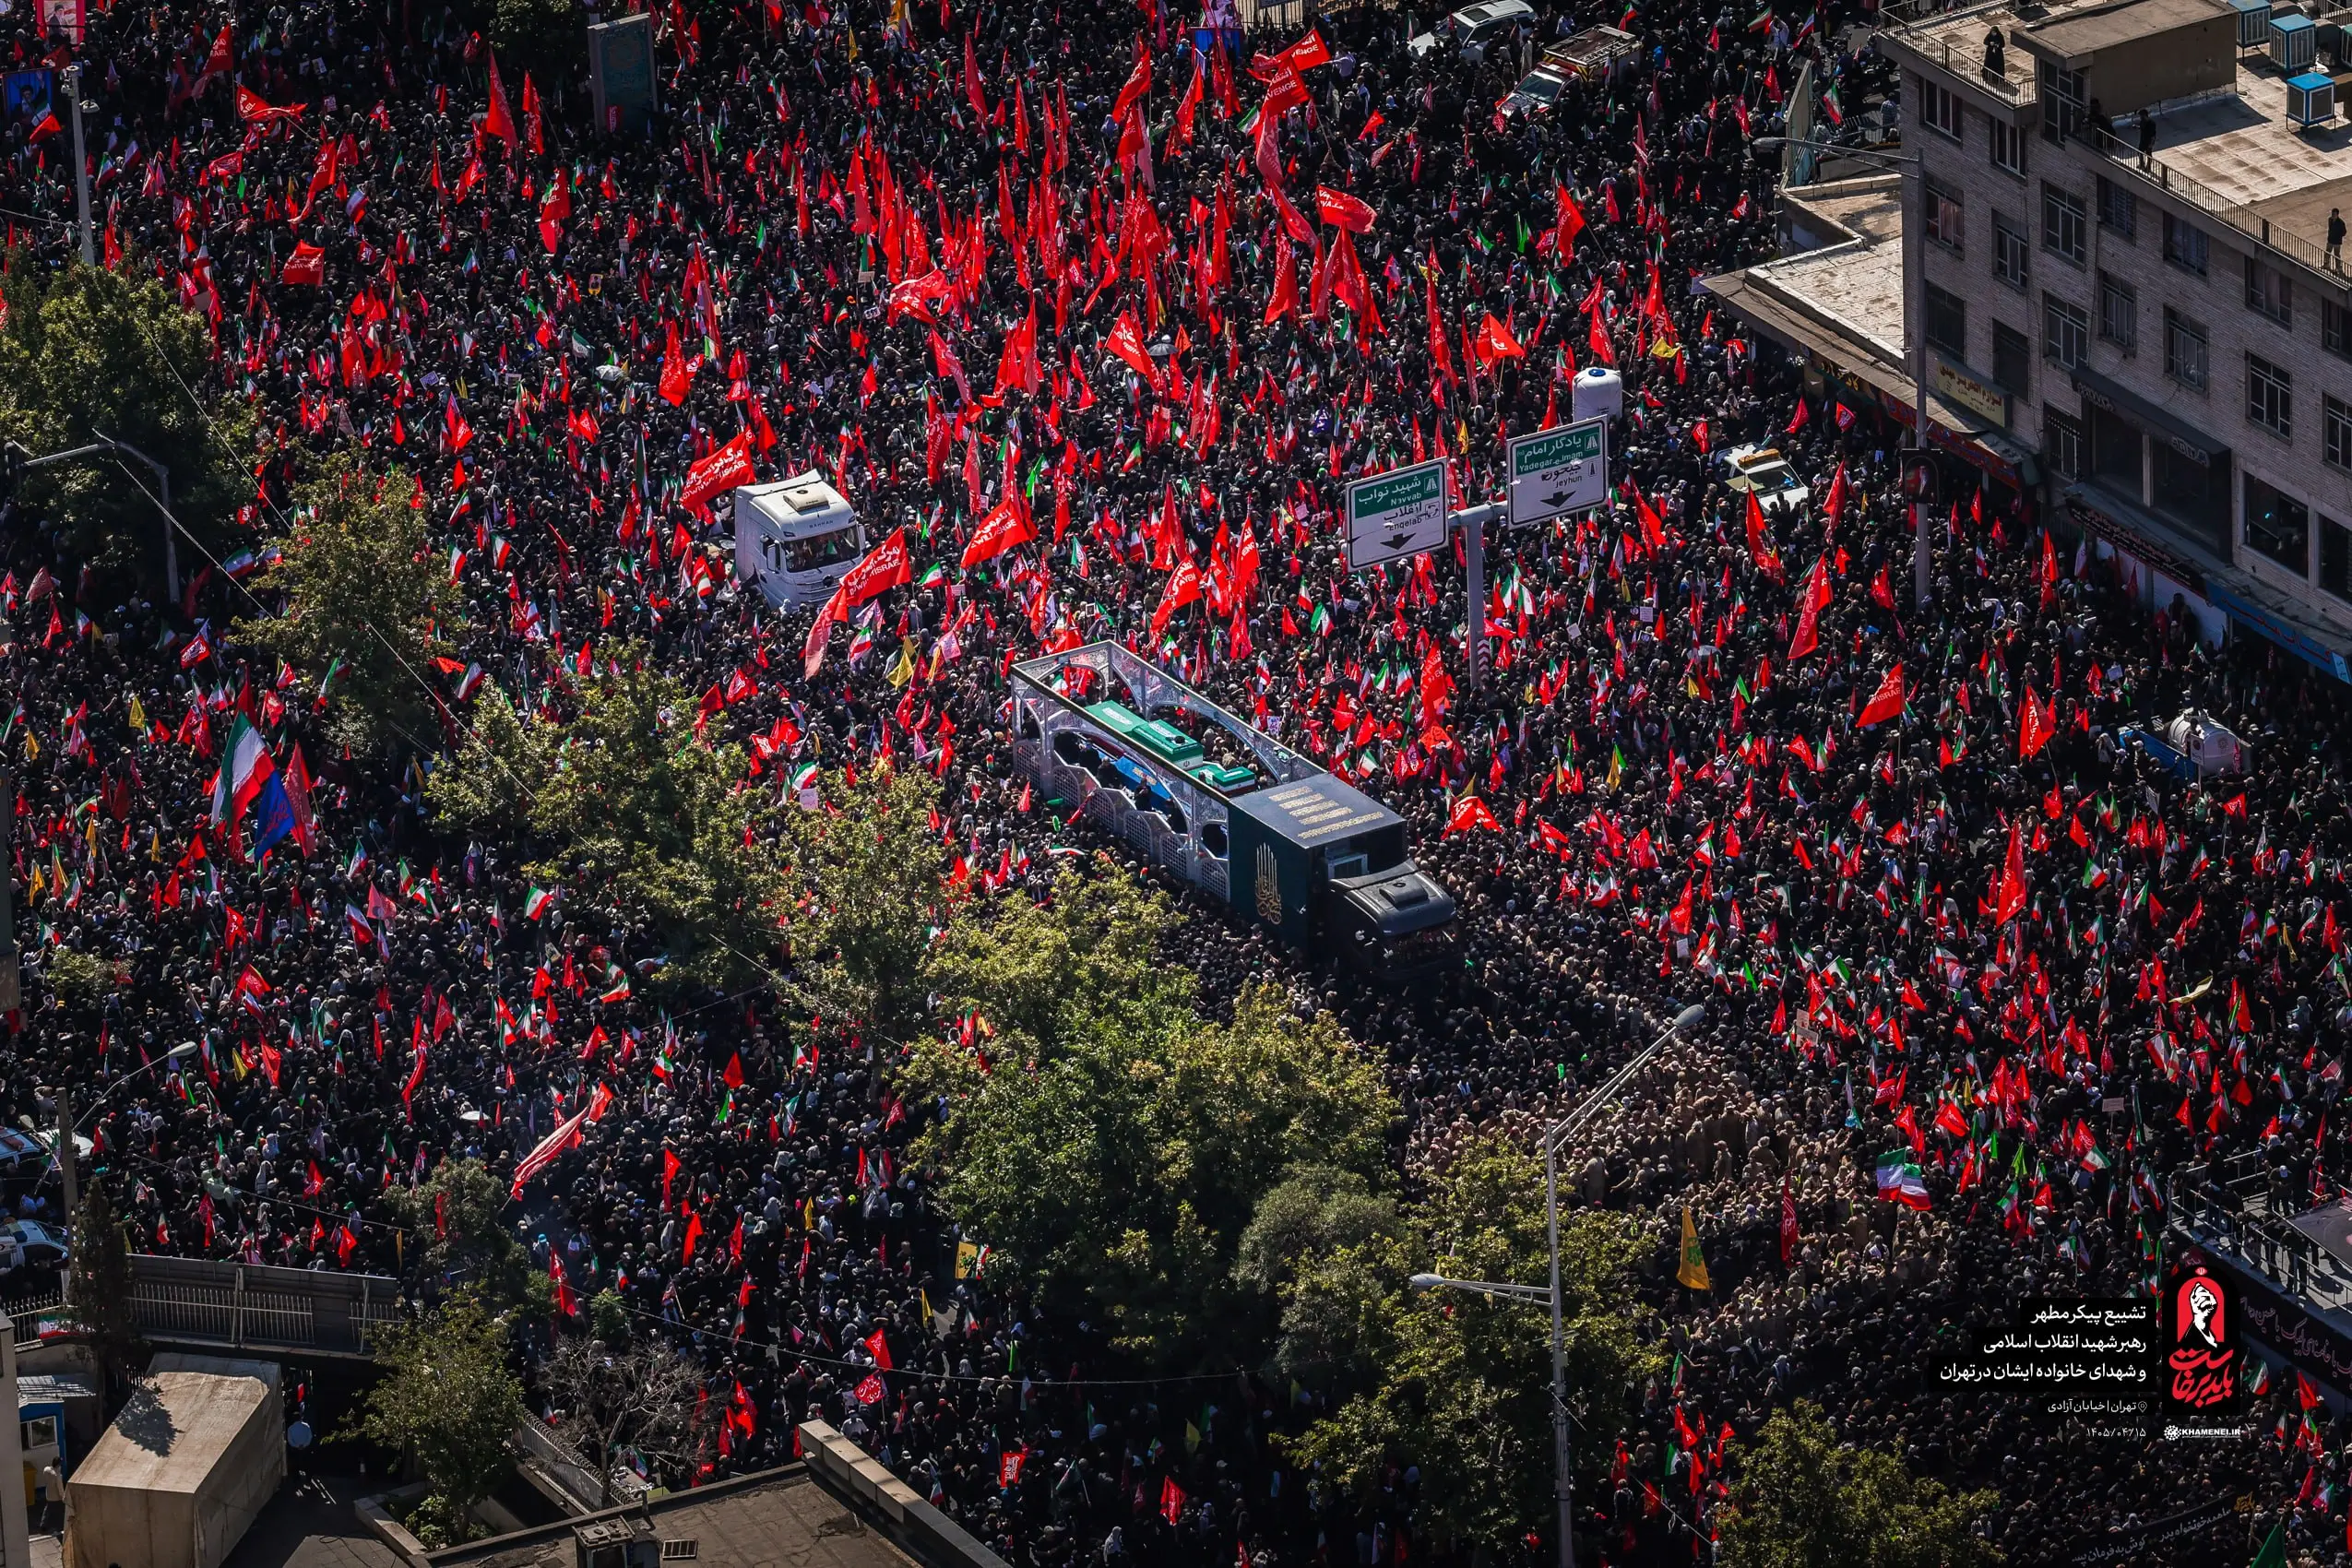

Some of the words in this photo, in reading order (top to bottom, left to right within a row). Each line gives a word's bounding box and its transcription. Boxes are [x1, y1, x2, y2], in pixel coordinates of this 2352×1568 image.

[1525, 443, 1547, 464] امام
[1549, 435, 1582, 456] یادگار
[1392, 475, 1421, 494] شهید
[1359, 486, 1389, 505] نواب
[1384, 501, 1421, 523] انقلاب
